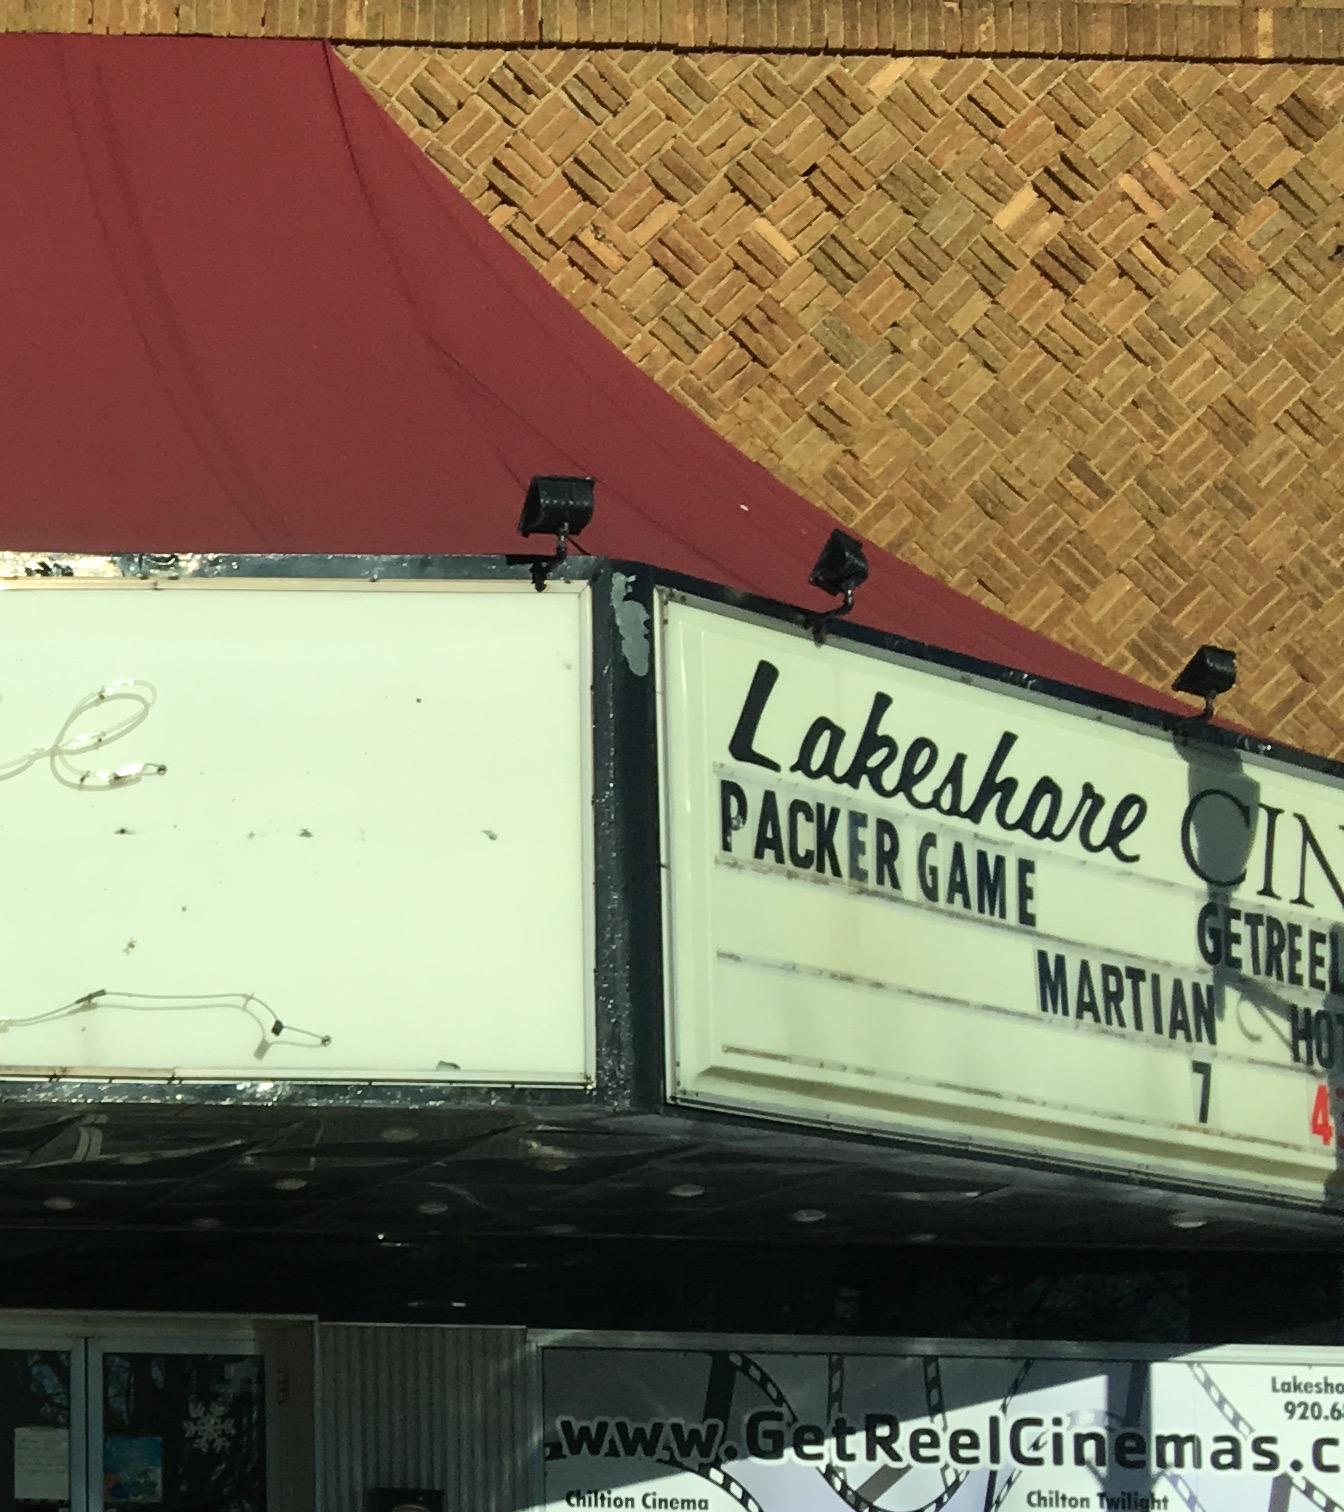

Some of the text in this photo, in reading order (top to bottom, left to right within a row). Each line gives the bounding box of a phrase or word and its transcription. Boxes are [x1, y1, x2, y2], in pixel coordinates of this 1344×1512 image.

[728, 659, 1344, 908] Lakeshore CIN
[721, 779, 1037, 927] PACKER GAME
[1036, 948, 1217, 1045] MARTIAN
[1191, 1061, 1211, 1124] 7
[561, 1410, 1341, 1473] www.GetReelCinemas.c
[1284, 1400, 1344, 1421] 920.6
[565, 1488, 709, 1512] Chiltion Cinema
[1026, 1490, 1090, 1510] Chilton
